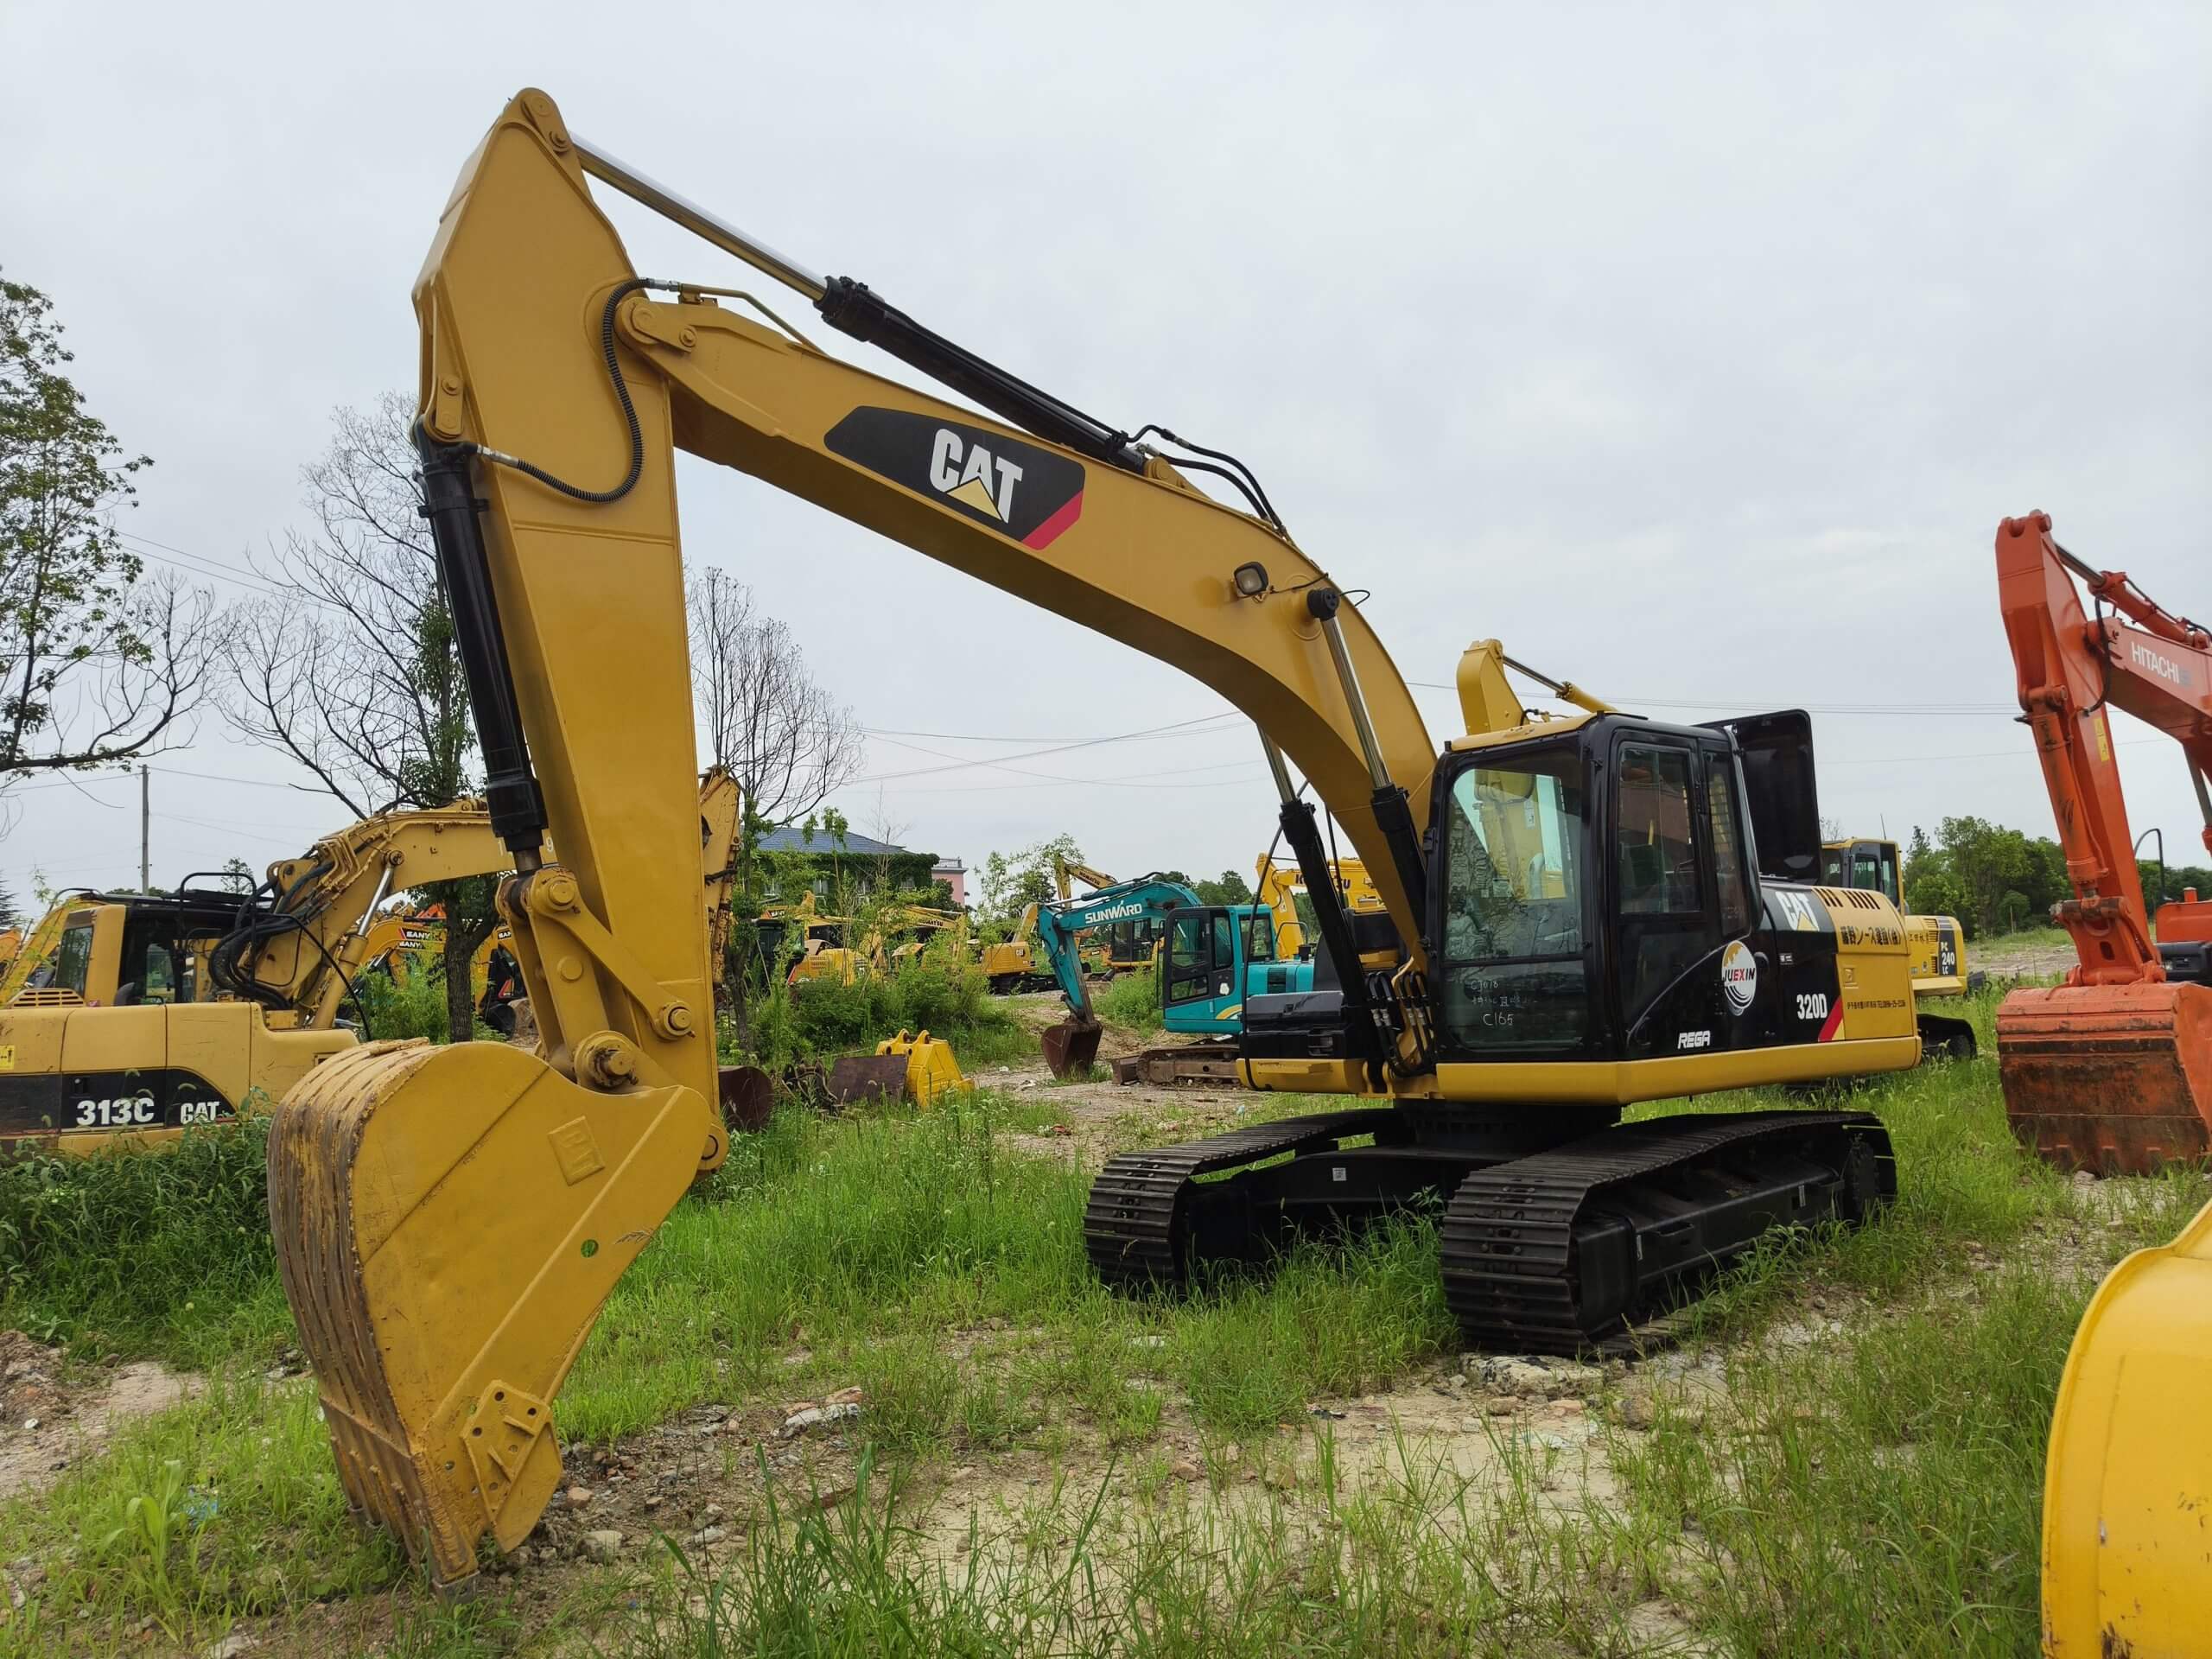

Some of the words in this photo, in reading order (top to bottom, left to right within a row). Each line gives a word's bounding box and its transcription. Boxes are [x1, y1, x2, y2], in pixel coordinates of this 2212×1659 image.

[929, 428, 1024, 524] CAT
[2131, 641, 2180, 683] HITACHI
[1085, 899, 1142, 924] SUNWARD
[1776, 891, 1821, 932] CAT
[399, 941, 422, 950] SANY
[406, 931, 430, 940] SANY
[1941, 942, 1948, 951] PC
[1942, 952, 1955, 965] 240
[1722, 968, 1755, 982] JUEXIN
[1942, 966, 1948, 975] LC
[1796, 994, 1827, 1020] 320D
[1483, 1012, 1514, 1027] C165
[1677, 1030, 1711, 1050] REGA
[76, 1097, 155, 1126] 313C
[180, 1101, 220, 1125] CAT
